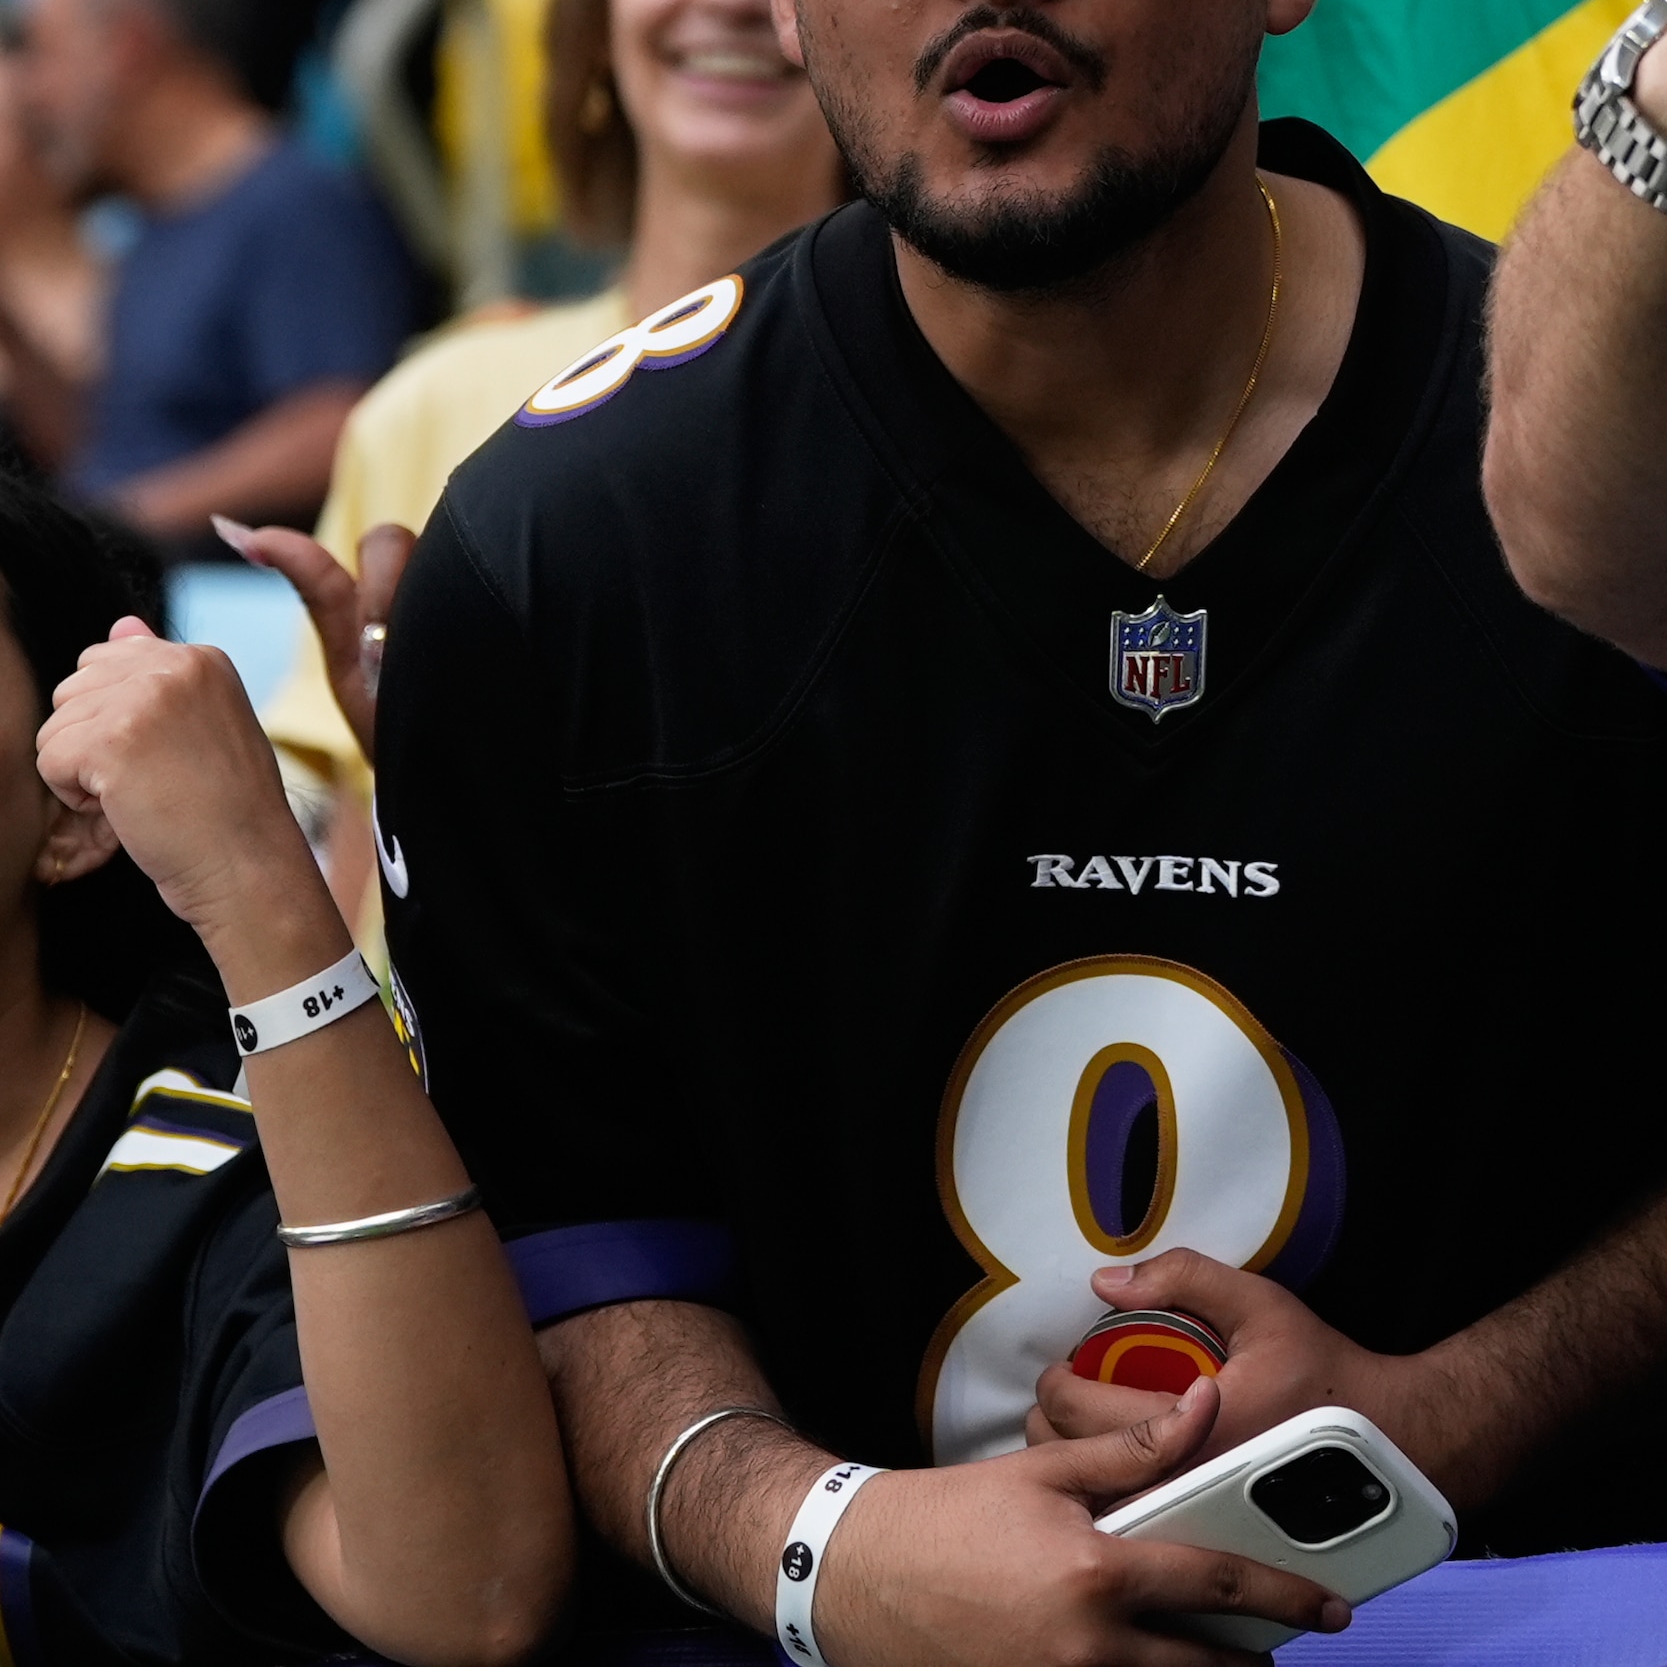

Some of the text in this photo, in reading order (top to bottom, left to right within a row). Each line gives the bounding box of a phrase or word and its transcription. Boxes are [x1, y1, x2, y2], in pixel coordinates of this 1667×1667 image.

[513, 273, 745, 428] 8
[1124, 655, 1192, 700] NFL
[1027, 853, 1280, 898] RAVENS
[788, 1543, 806, 1579] +18
